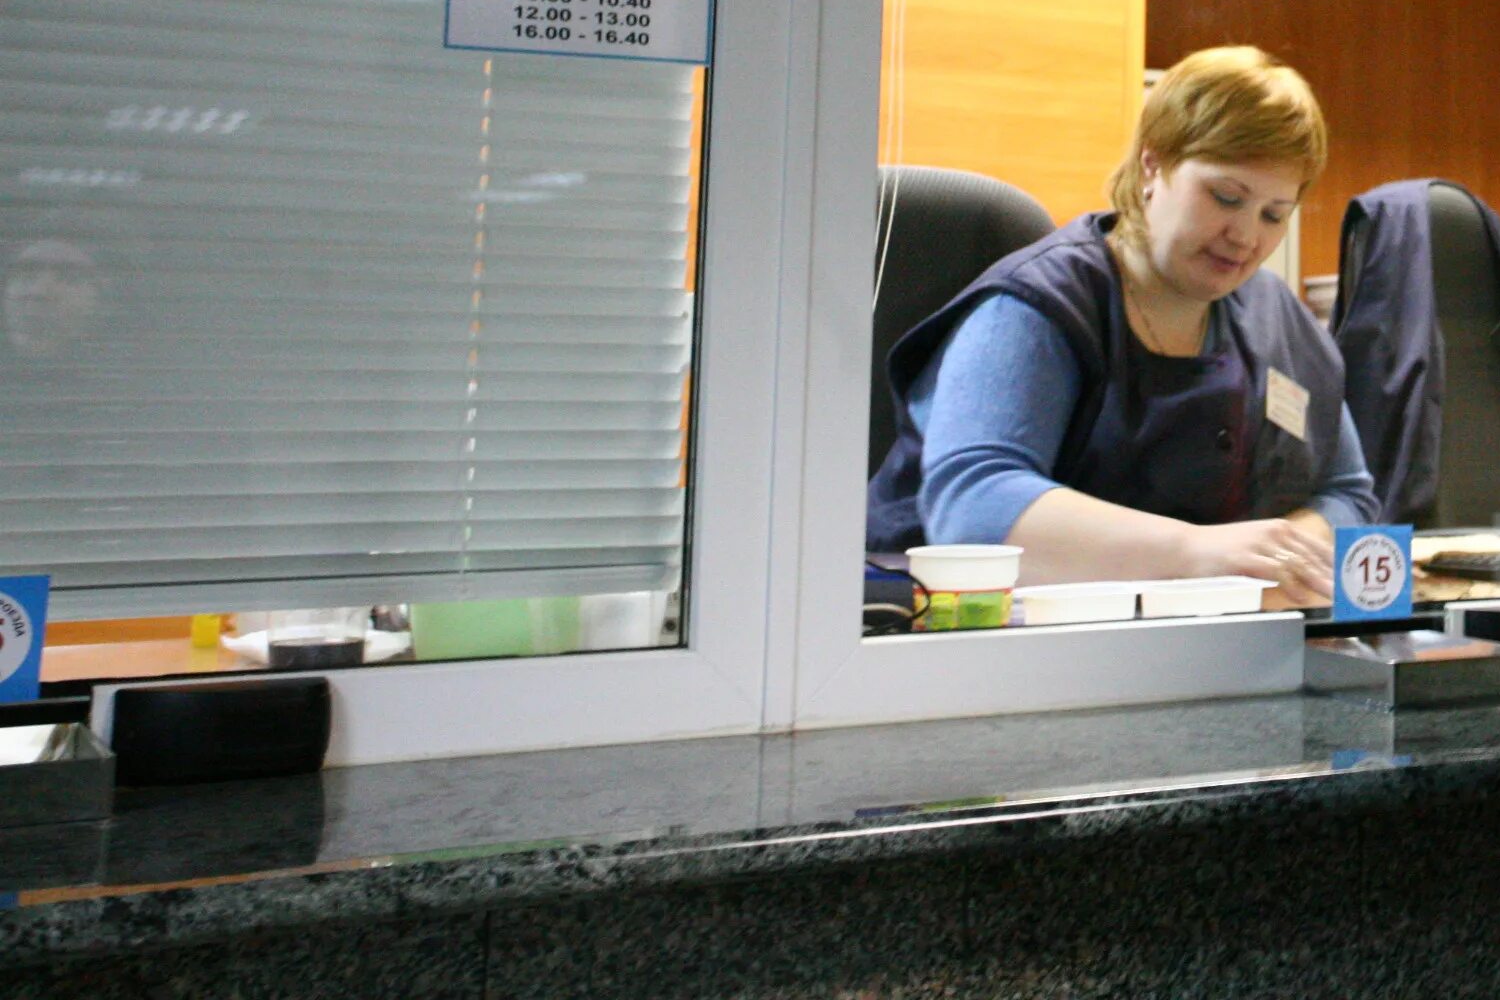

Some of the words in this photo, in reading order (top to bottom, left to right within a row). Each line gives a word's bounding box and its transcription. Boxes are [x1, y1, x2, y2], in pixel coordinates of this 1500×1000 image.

[514, 6, 572, 22] 12.00
[595, 12, 651, 27] 13.00
[513, 25, 571, 41] 16.00
[594, 30, 650, 46] 16.40
[1358, 555, 1392, 585] 15
